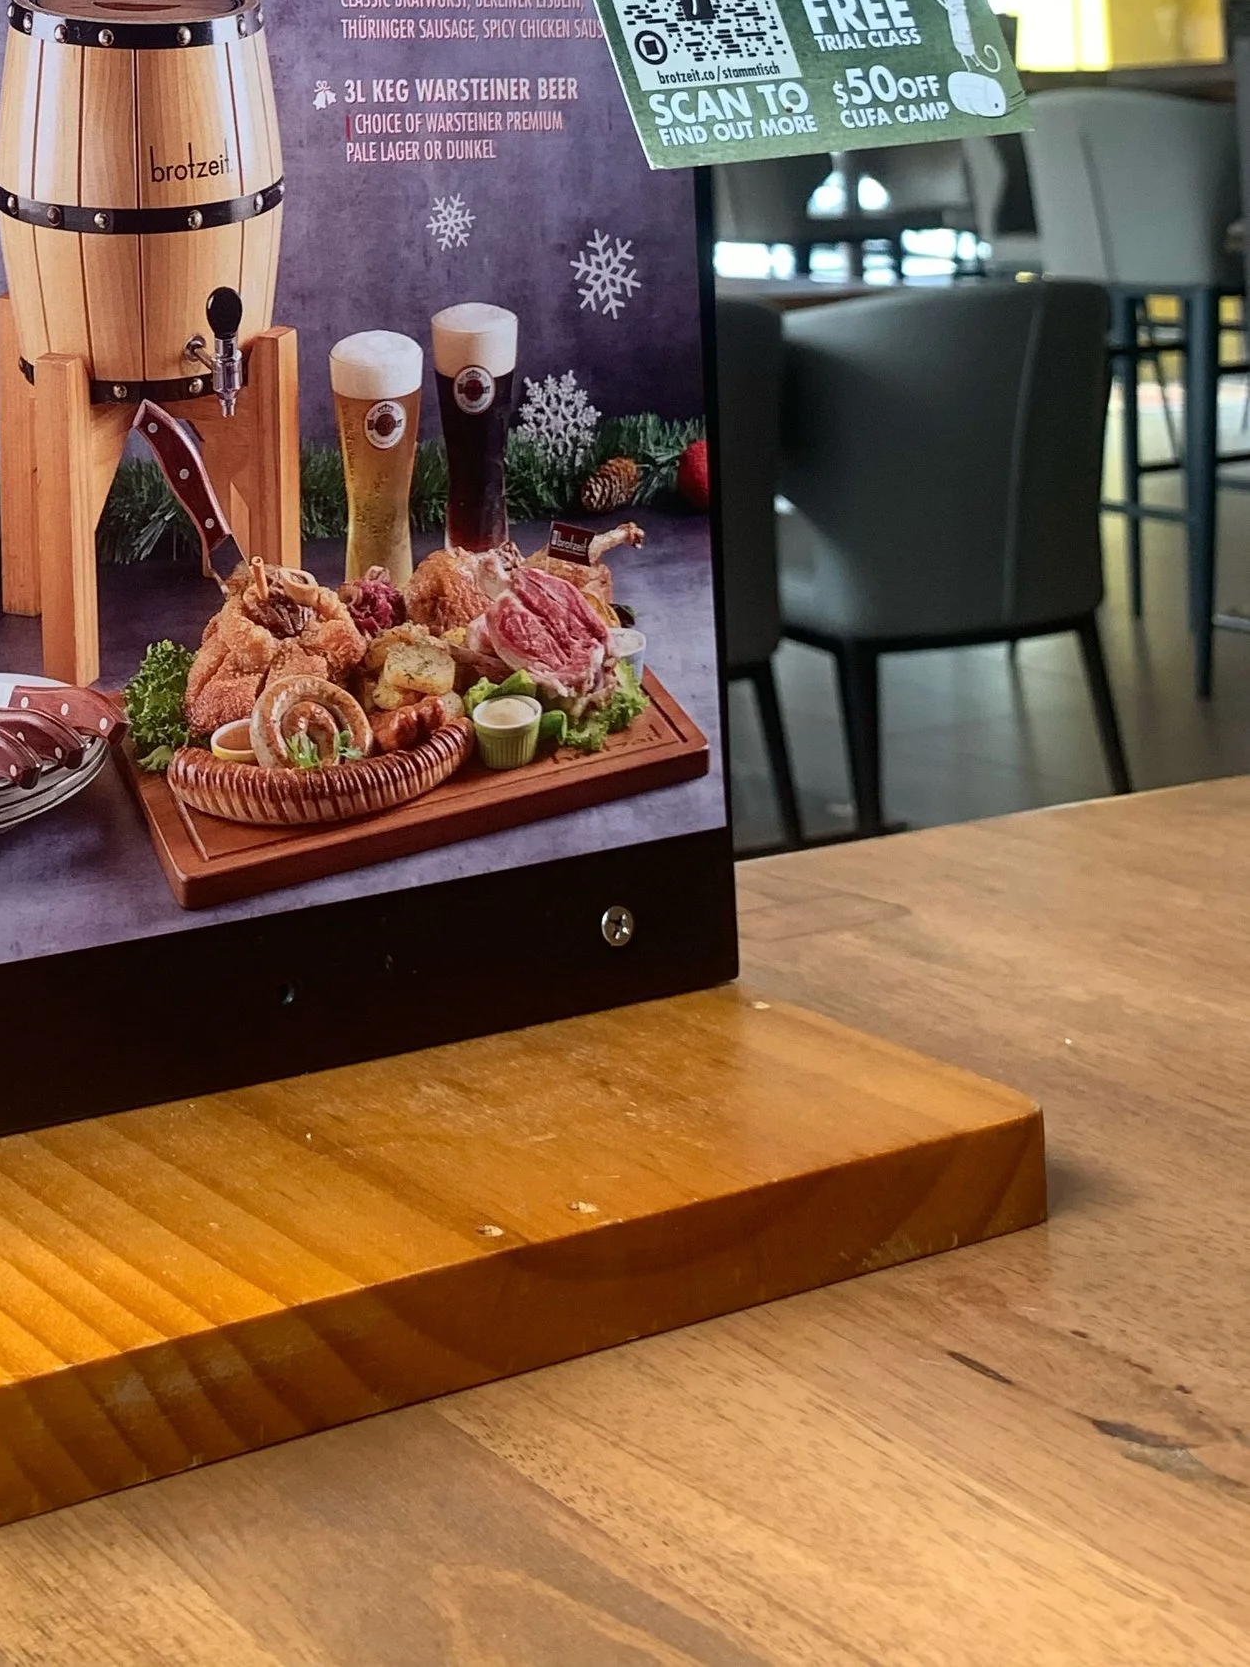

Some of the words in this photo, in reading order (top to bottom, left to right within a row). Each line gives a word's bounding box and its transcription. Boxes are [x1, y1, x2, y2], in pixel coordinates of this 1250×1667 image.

[340, 15, 415, 40] THÜRINGER
[419, 18, 479, 42] SAUSAGE,
[483, 18, 516, 40] SPICY
[520, 18, 571, 40] CHICKEN
[574, 18, 605, 40] SAUS
[813, 32, 867, 52] TRIAL
[867, 28, 922, 47] CLASS
[344, 79, 366, 103] 3L
[372, 79, 409, 103] KEG
[415, 78, 531, 103] WARSTEINER
[537, 77, 579, 101] BEER
[649, 86, 753, 126] SCAN
[756, 81, 809, 115] TO
[355, 113, 402, 135] CHOICE
[405, 112, 423, 133] OF
[425, 111, 503, 133] WARSTEINER
[506, 110, 563, 131] PREMIUM
[840, 107, 893, 129] CUFA
[895, 101, 950, 123] CAMP
[658, 126, 708, 147] FIND
[712, 120, 754, 142] OUT
[759, 115, 818, 137] MORE
[150, 138, 232, 183] brotzeit
[346, 142, 377, 163] PALE
[380, 141, 421, 162] LAGER
[424, 140, 443, 160] OR
[446, 139, 497, 160] DUNKEL
